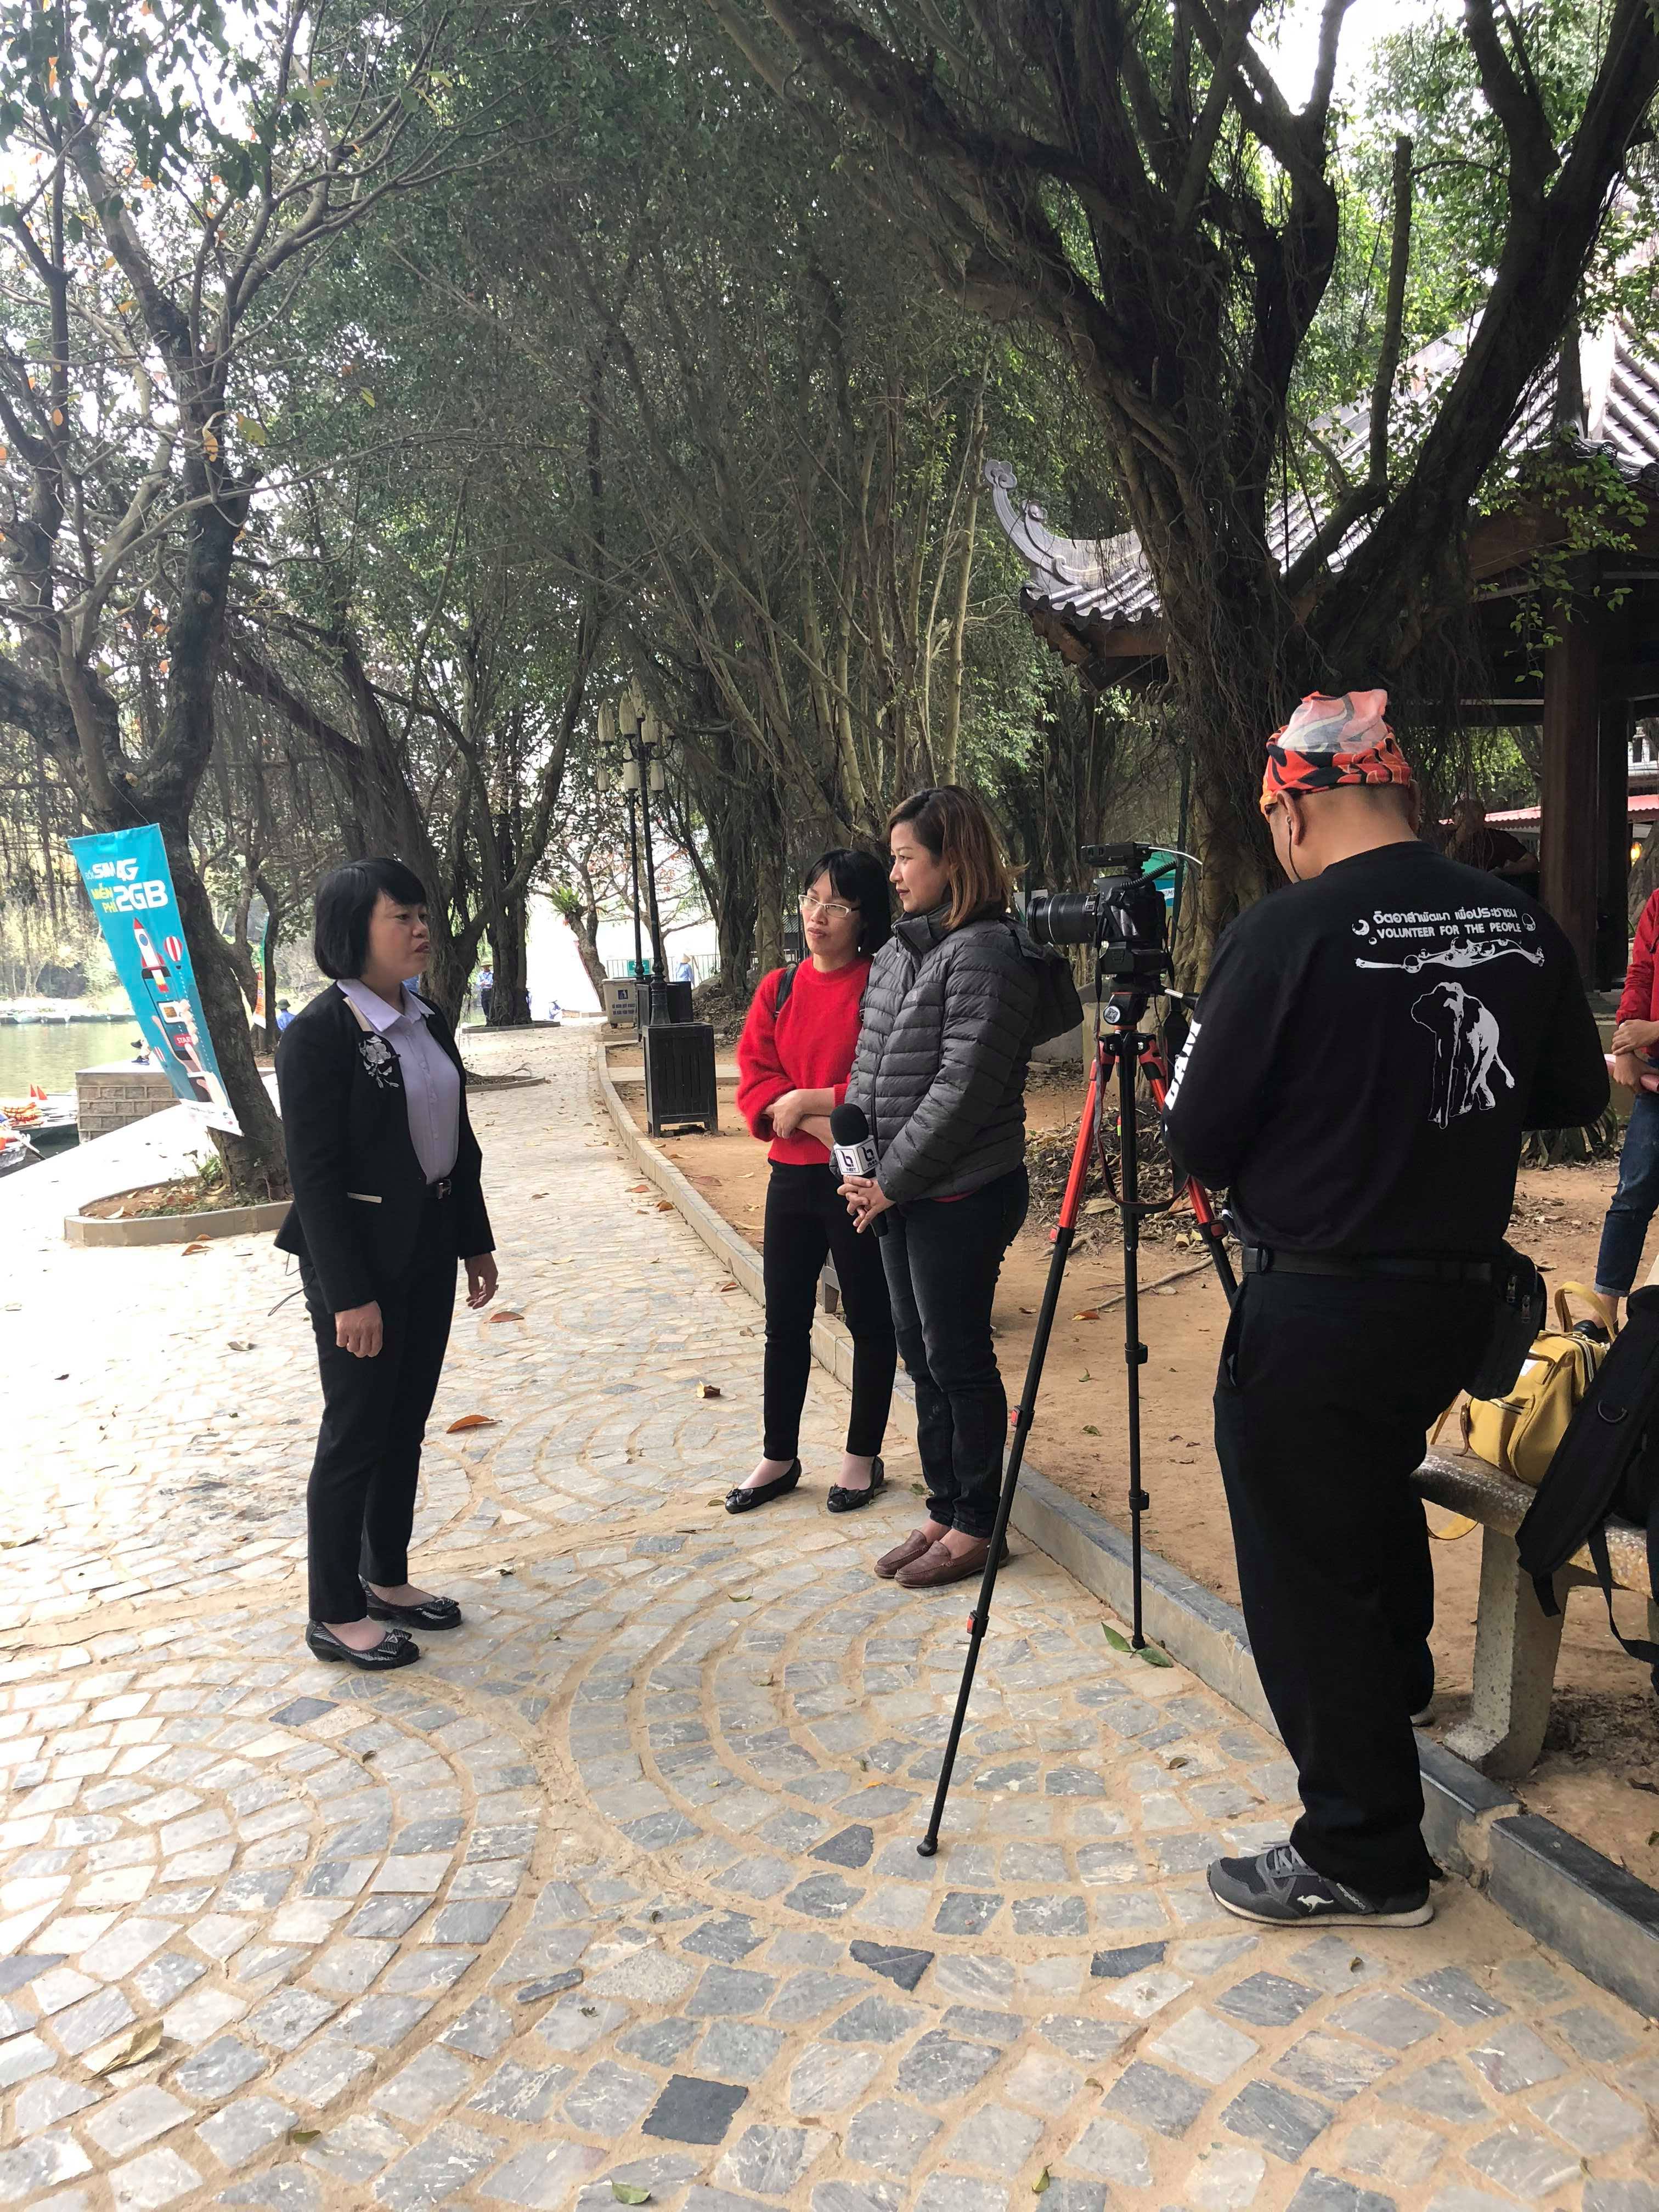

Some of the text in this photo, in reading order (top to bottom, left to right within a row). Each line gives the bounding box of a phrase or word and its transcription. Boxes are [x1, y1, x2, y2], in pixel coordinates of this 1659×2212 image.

[92, 861, 116, 879] SIM
[116, 858, 139, 881] 4G
[114, 879, 168, 912] 2GB
[1376, 922, 1522, 939] VOLUNTEER FOR THE PEOPLE
[176, 1036, 193, 1045] STAR
